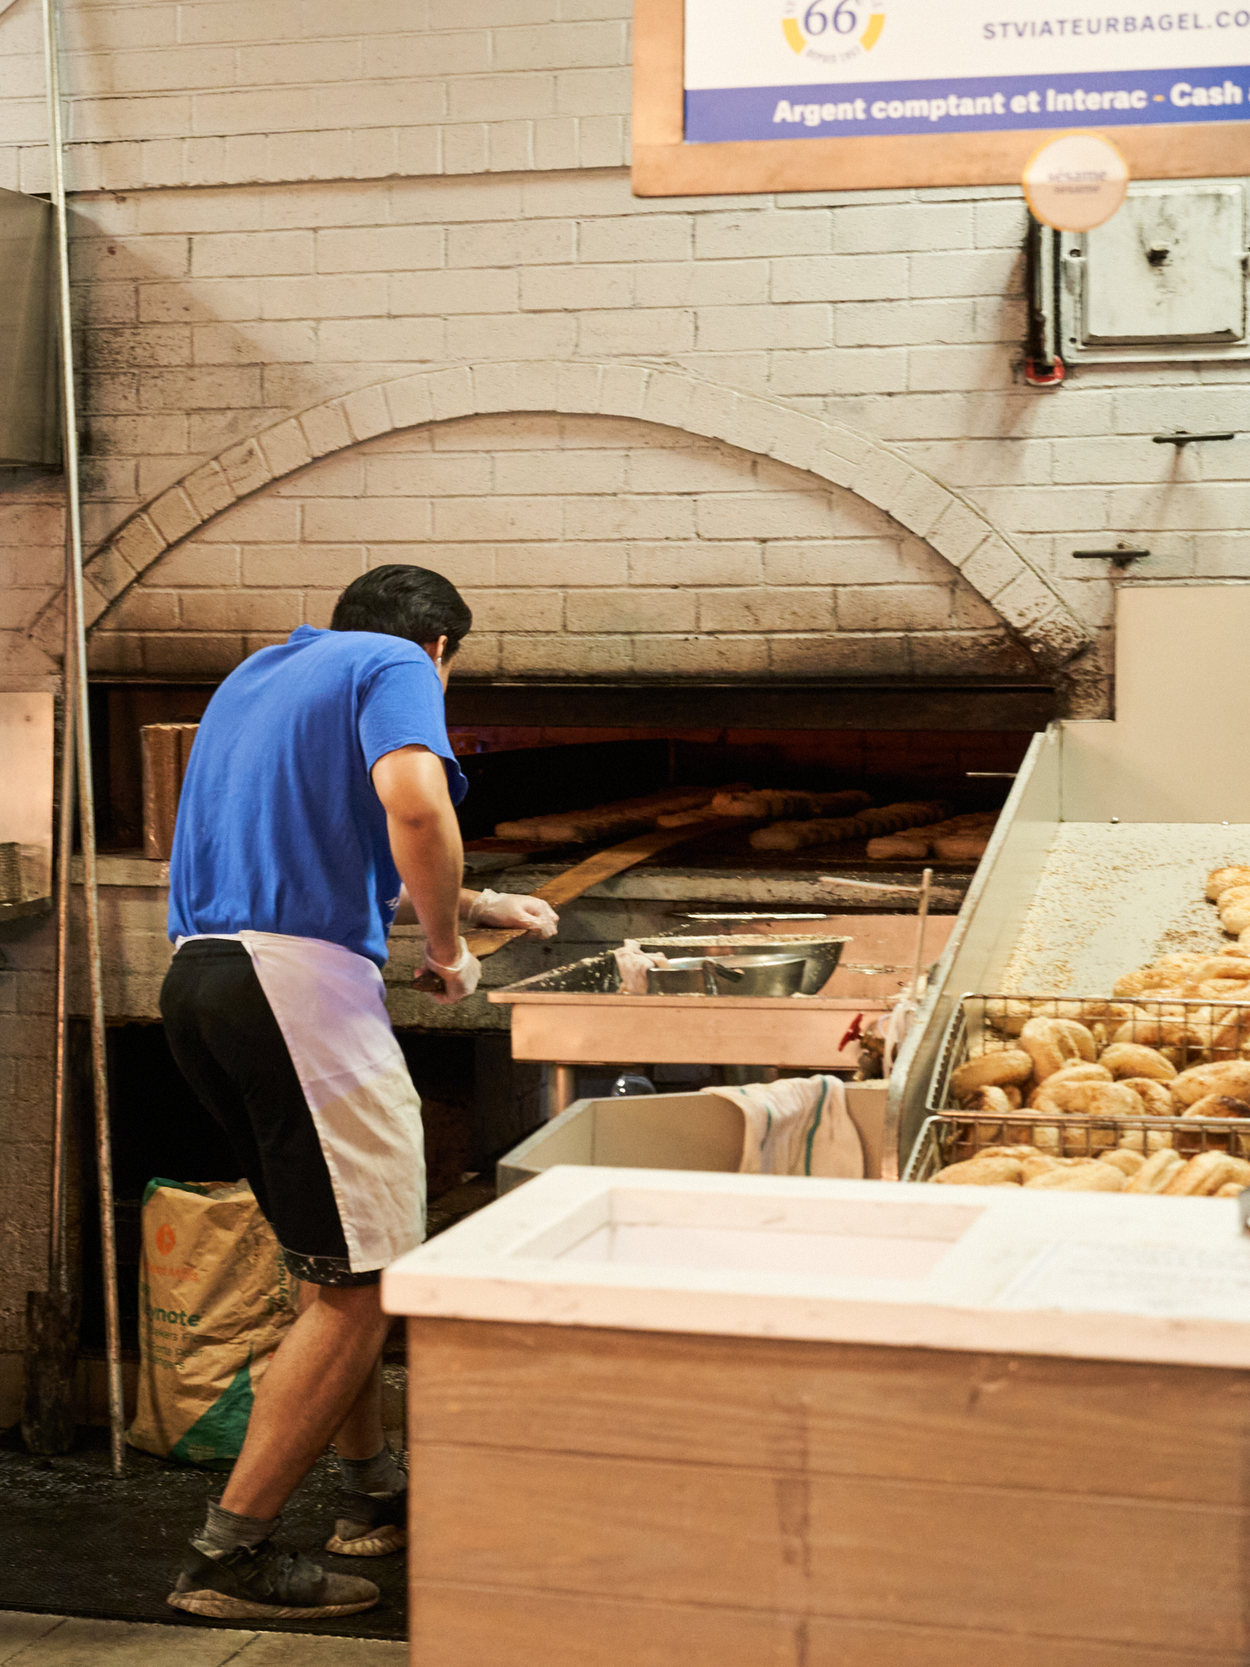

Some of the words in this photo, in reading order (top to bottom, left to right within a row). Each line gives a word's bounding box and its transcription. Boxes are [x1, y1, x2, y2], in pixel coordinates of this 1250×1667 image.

[804, 0, 857, 36] 66
[772, 97, 867, 127] Argent
[870, 91, 1006, 122] comptant
[1010, 90, 1041, 114] et
[1046, 87, 1148, 112] Interac
[1170, 79, 1244, 107] Cash
